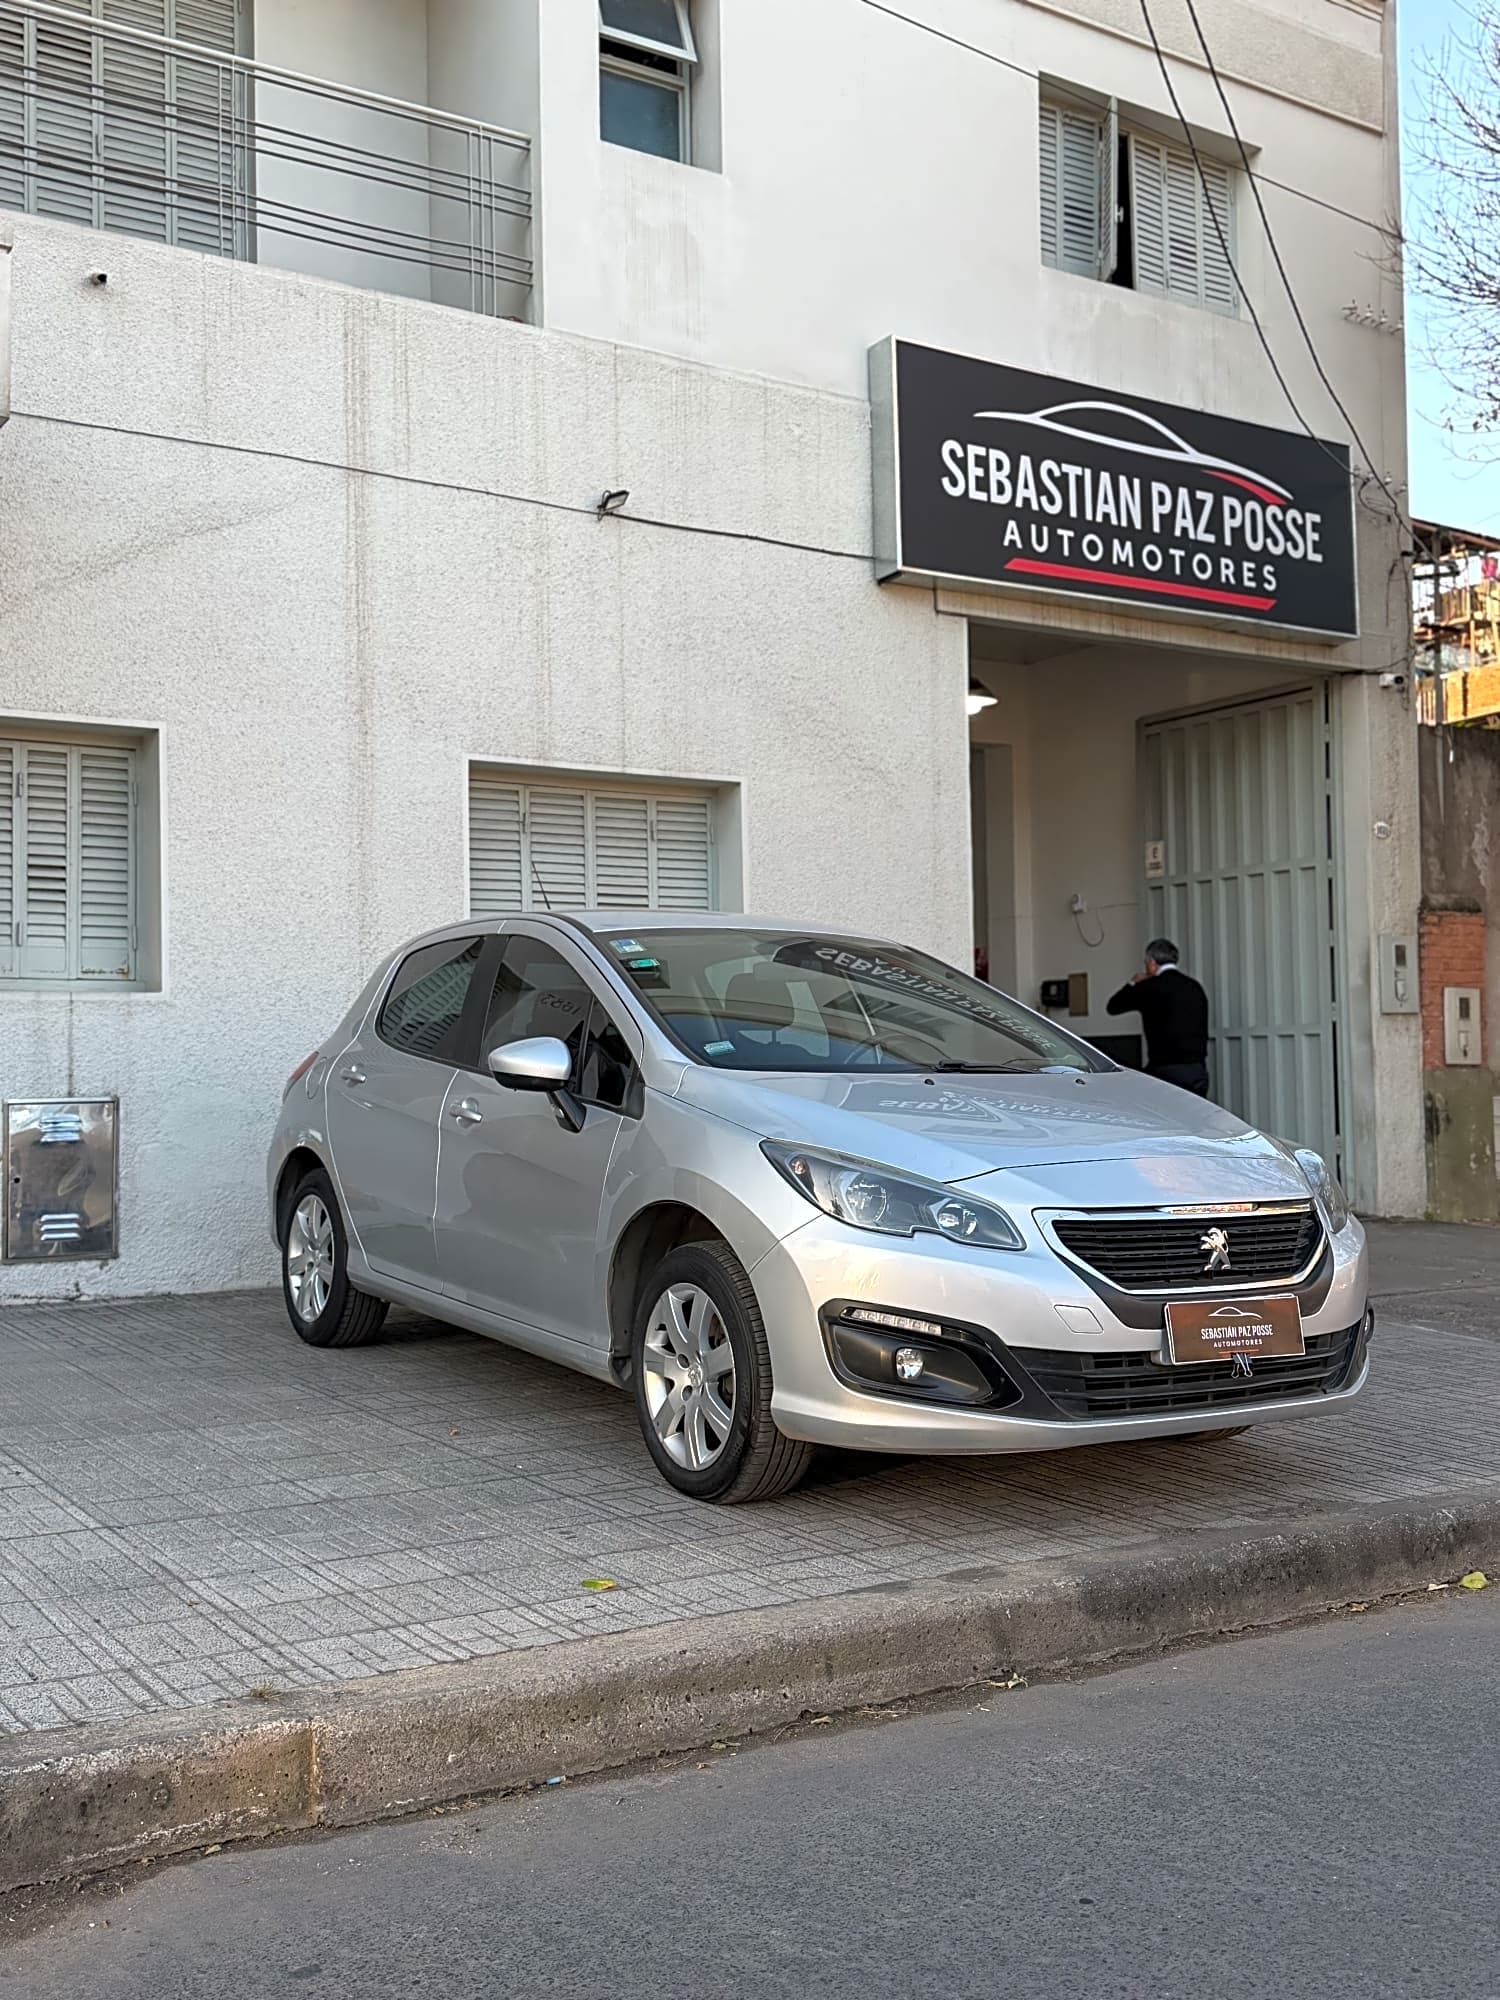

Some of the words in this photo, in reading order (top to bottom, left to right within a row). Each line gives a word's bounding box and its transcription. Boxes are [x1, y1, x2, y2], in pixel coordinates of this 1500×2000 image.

[941, 439, 1142, 530] SEBASTIAN
[1151, 481, 1216, 544] PAZ
[1222, 496, 1323, 563] POSSE
[1003, 520, 1277, 591] AUTOMOTORES
[1213, 1338, 1263, 1348] AUTOMOTORES
[1238, 1325, 1251, 1337] PAZ
[1251, 1324, 1273, 1337] POSSE
